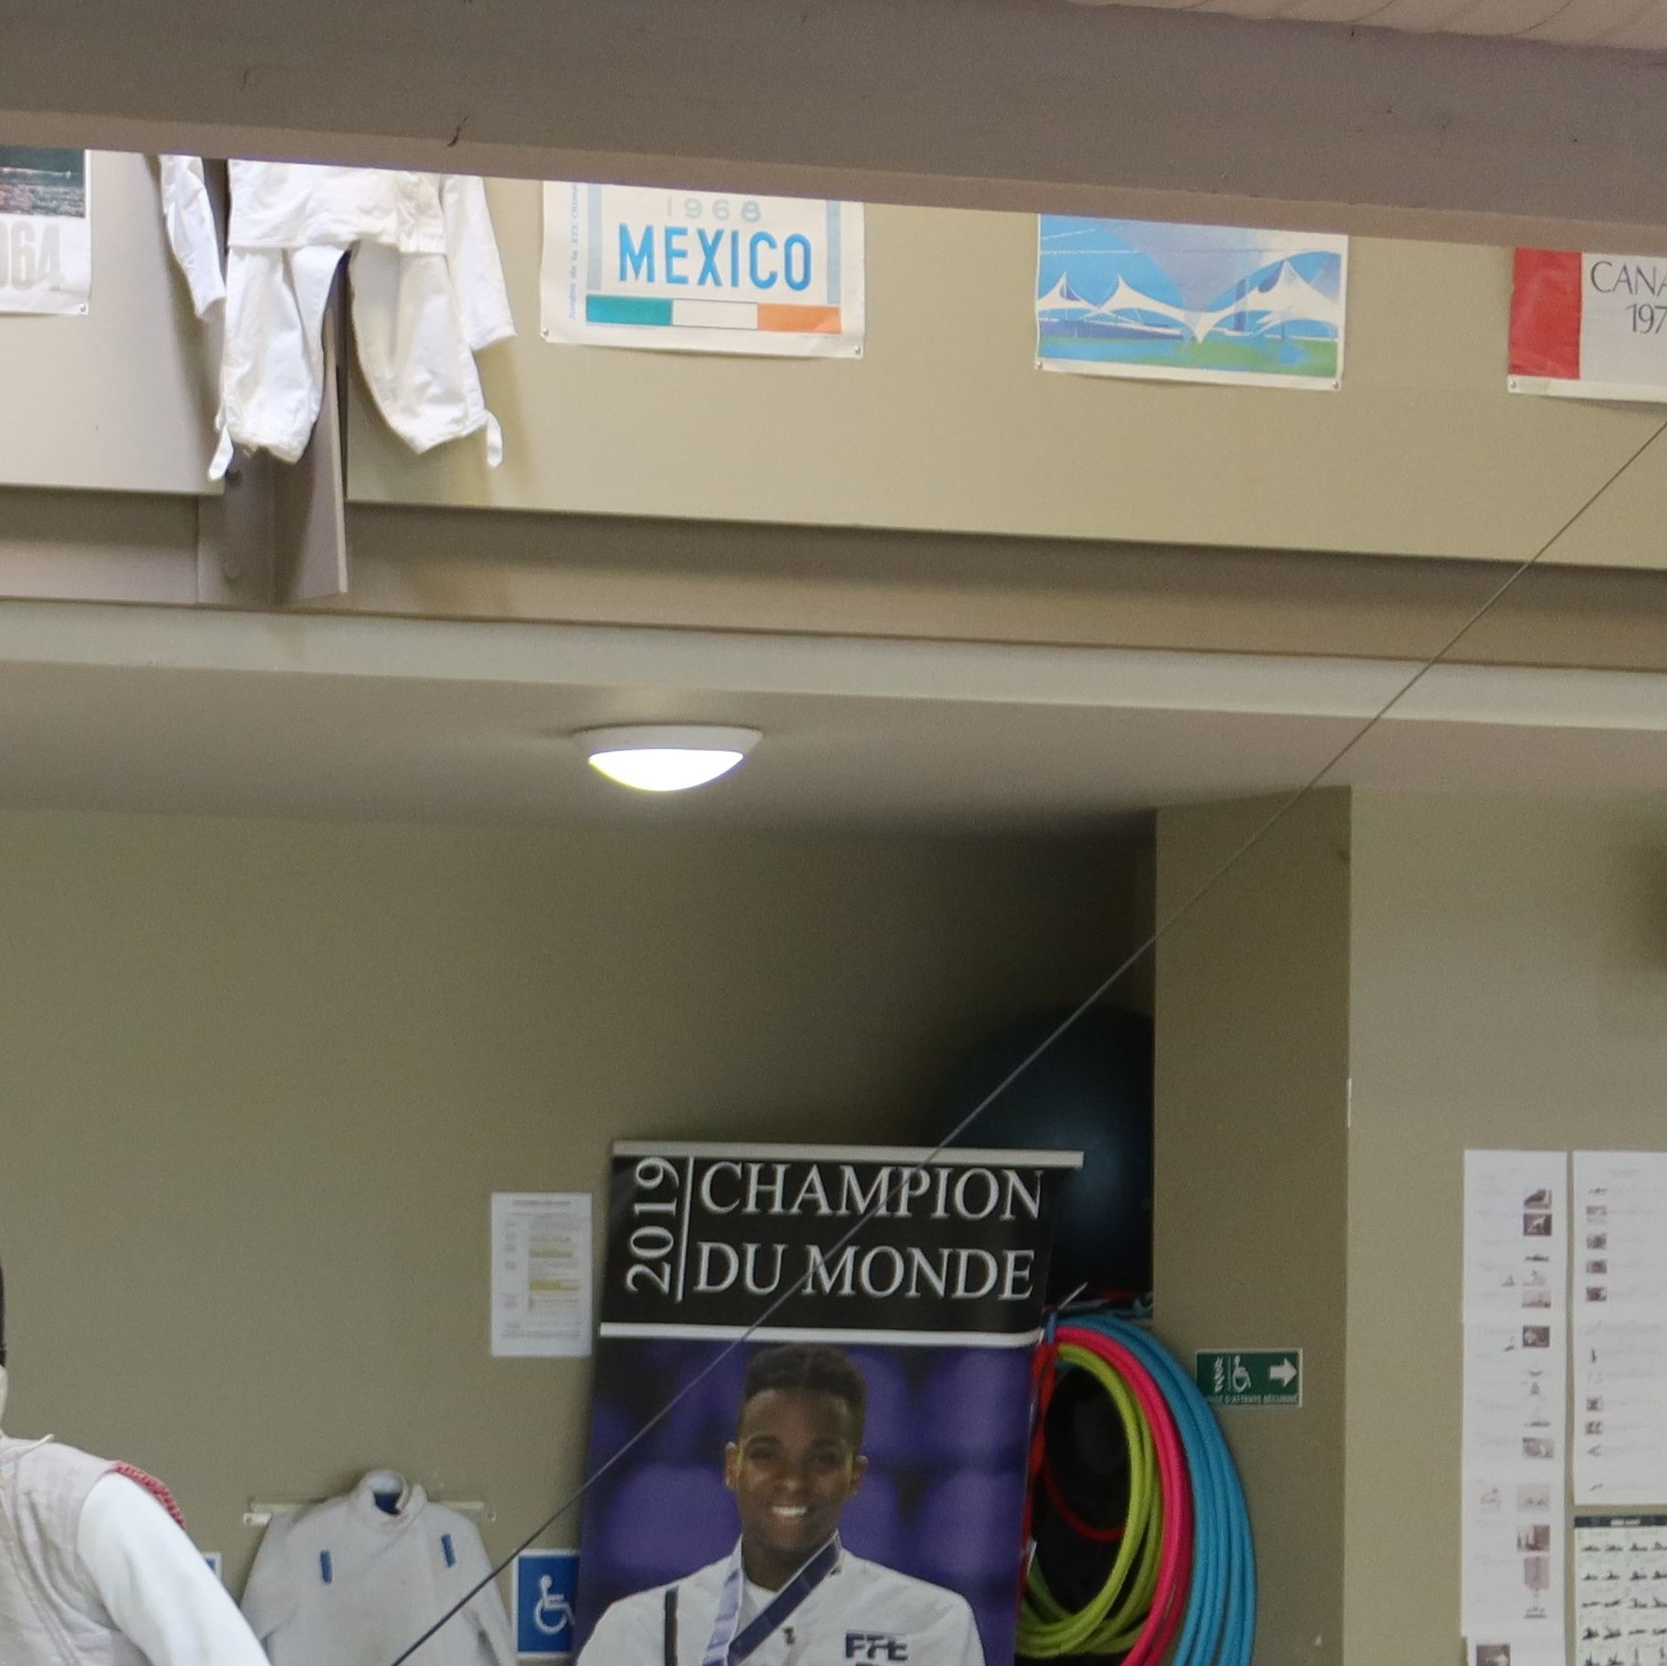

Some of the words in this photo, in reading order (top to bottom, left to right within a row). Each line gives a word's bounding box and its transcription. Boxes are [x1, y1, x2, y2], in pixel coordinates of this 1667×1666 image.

[667, 196, 762, 223] 1968
[618, 222, 812, 291] MEXICO
[698, 1161, 1044, 1222] CHAMPION
[624, 1156, 679, 1295] 2019
[693, 1241, 789, 1296] DU
[803, 1244, 1037, 1300] MONDE
